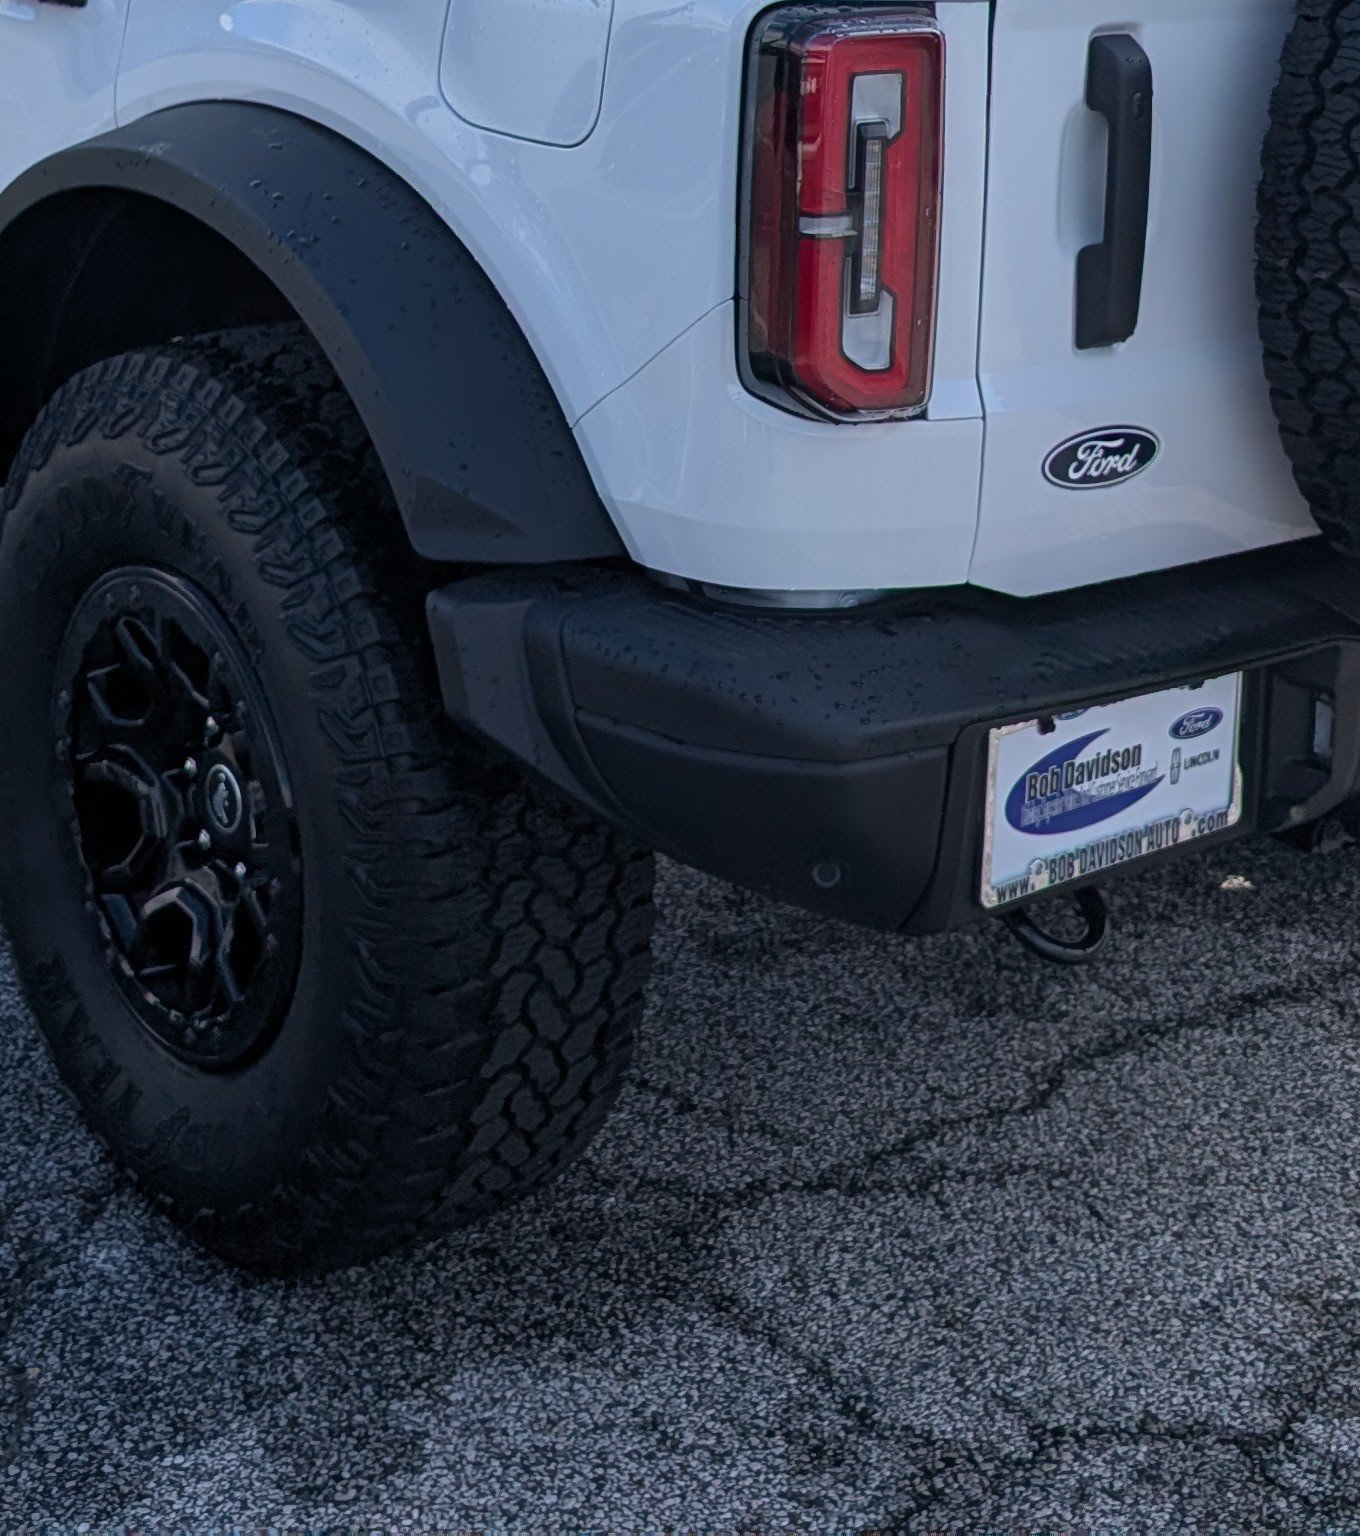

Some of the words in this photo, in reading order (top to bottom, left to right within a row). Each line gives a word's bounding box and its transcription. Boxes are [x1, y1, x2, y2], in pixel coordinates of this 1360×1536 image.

[1068, 437, 1140, 480] Ford
[1179, 713, 1213, 735] Ford
[1026, 765, 1060, 802] Bob
[1061, 743, 1142, 790] Davidson
[1183, 748, 1220, 770] LINCOLN
